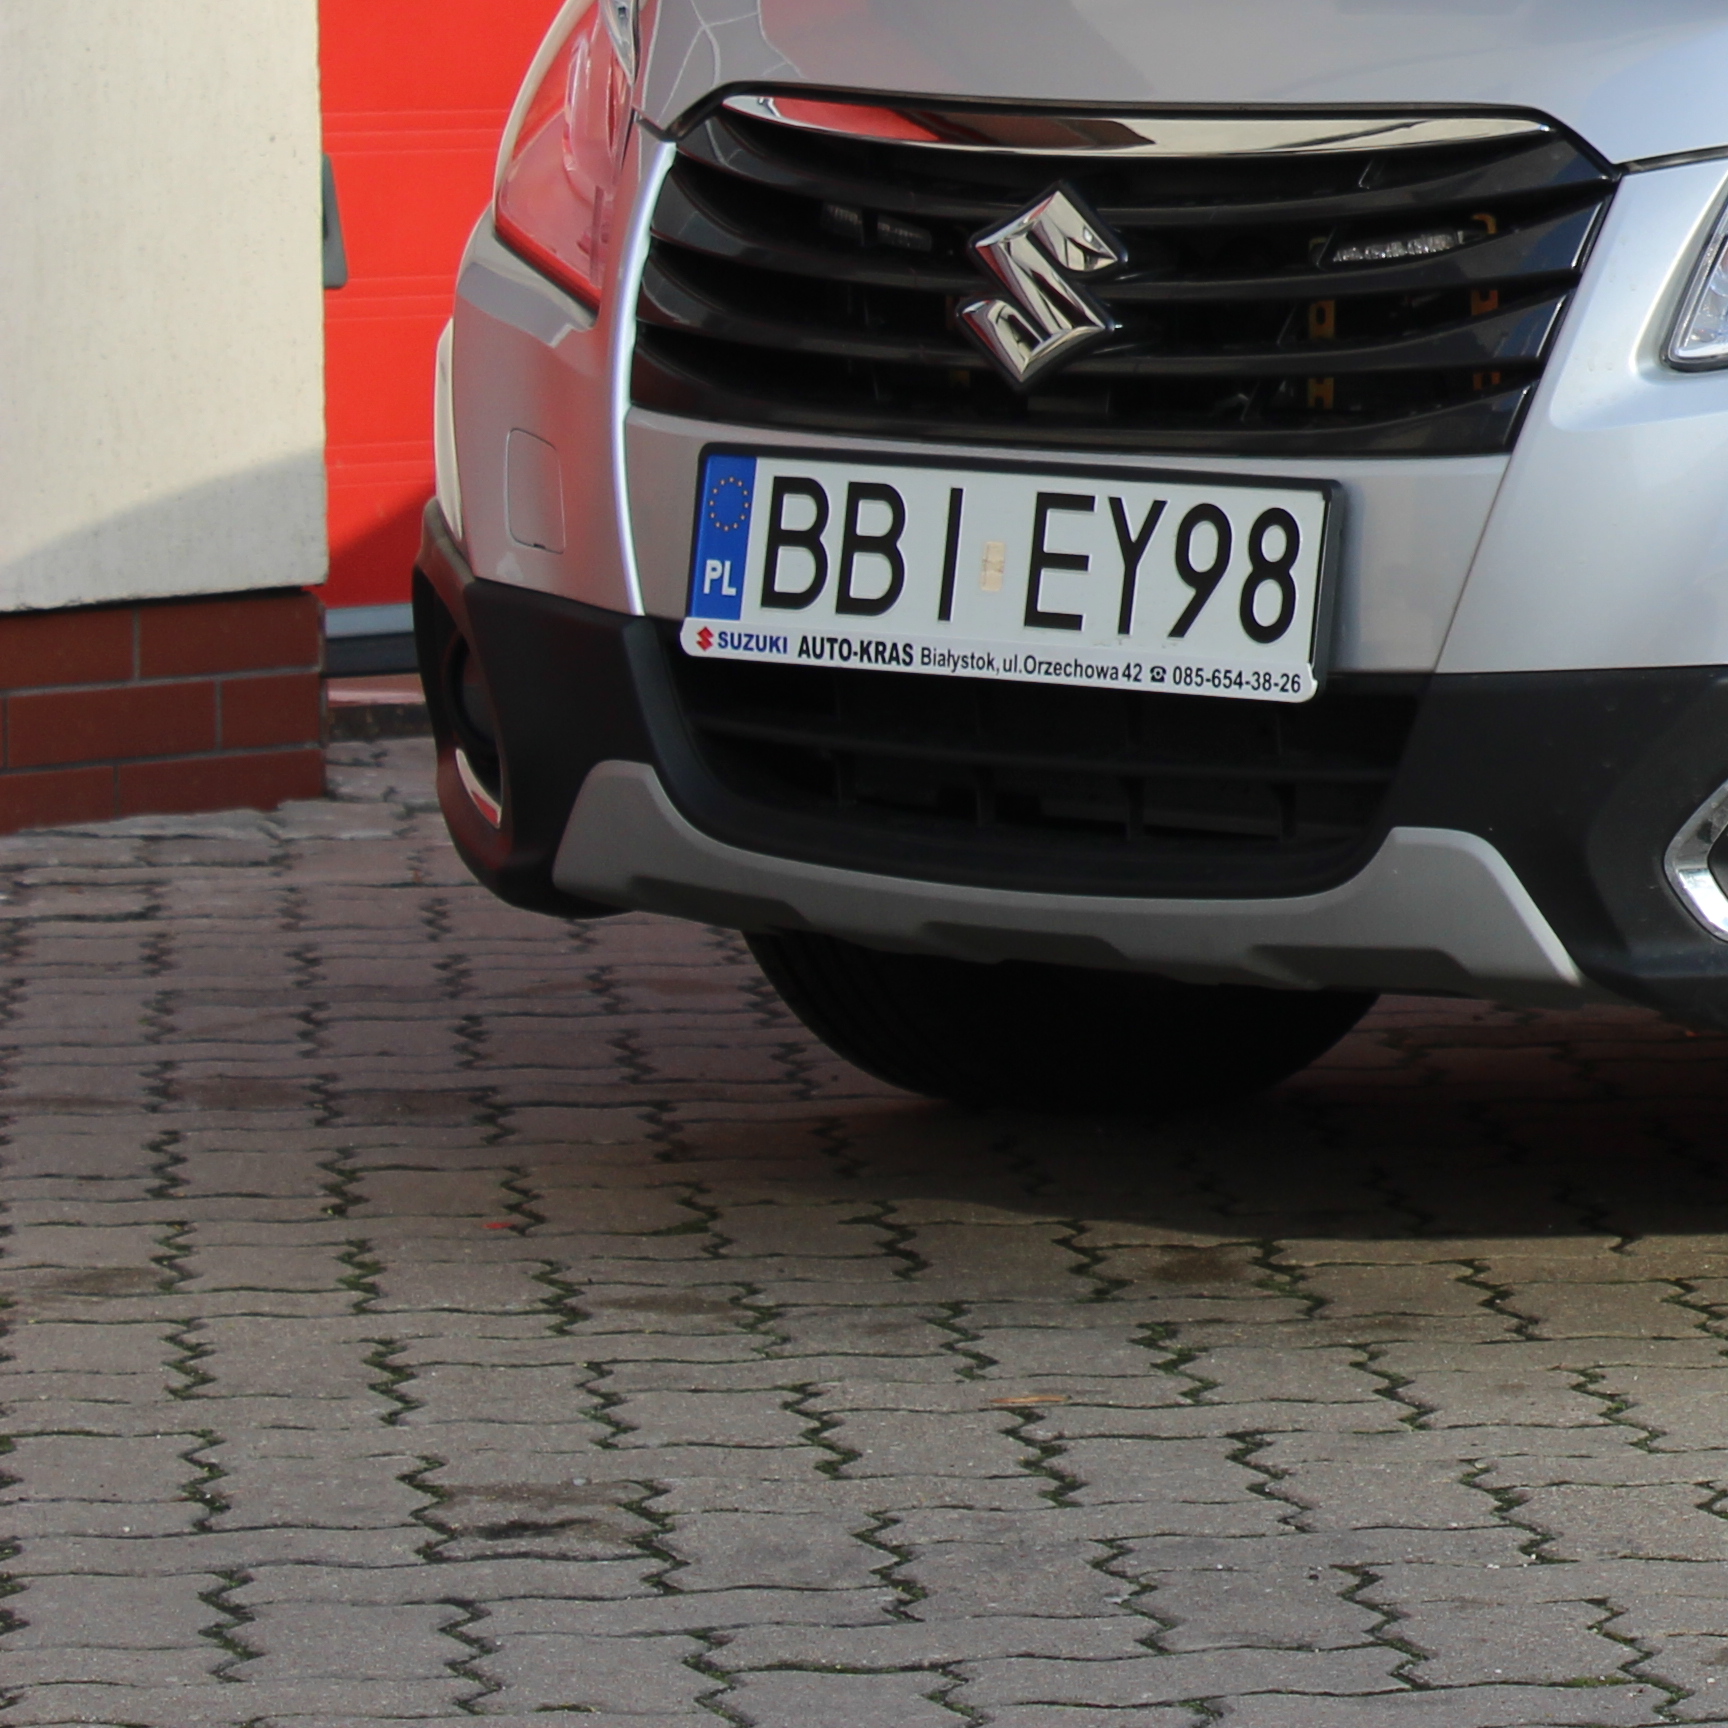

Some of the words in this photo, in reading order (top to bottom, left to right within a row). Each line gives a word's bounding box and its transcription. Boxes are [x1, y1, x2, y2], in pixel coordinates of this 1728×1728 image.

[703, 559, 737, 596] PL
[1024, 491, 1300, 644] EY98
[717, 631, 788, 654] SUZUKI
[798, 635, 914, 667] AUTO-KRAS
[921, 647, 1000, 676] Białystok,
[1122, 663, 1143, 682] 42
[1172, 666, 1301, 693] 085-654-38-26
